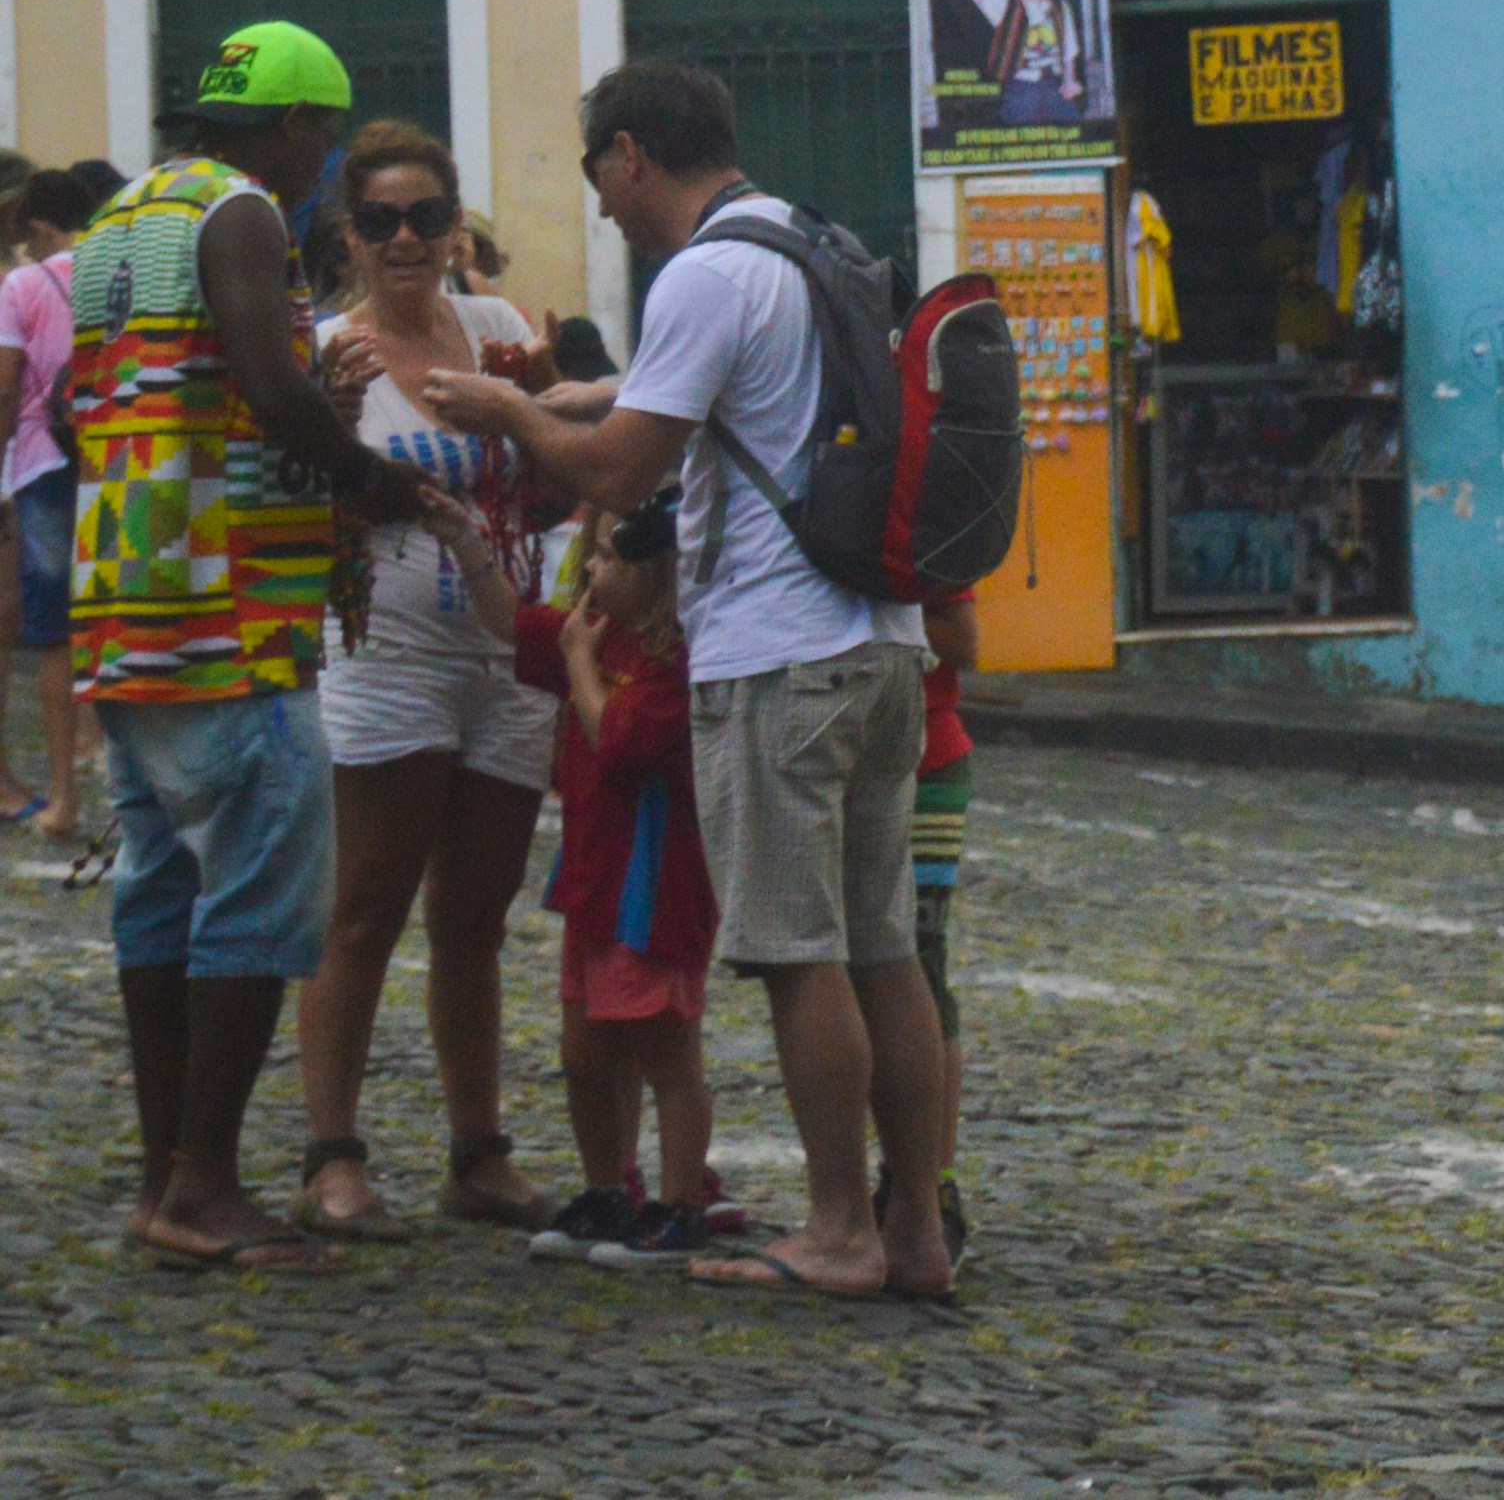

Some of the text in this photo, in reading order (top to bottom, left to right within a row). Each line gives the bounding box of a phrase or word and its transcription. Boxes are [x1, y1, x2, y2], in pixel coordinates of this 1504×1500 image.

[1198, 31, 1332, 69] FILMES
[1200, 88, 1335, 117] E PILHAS
